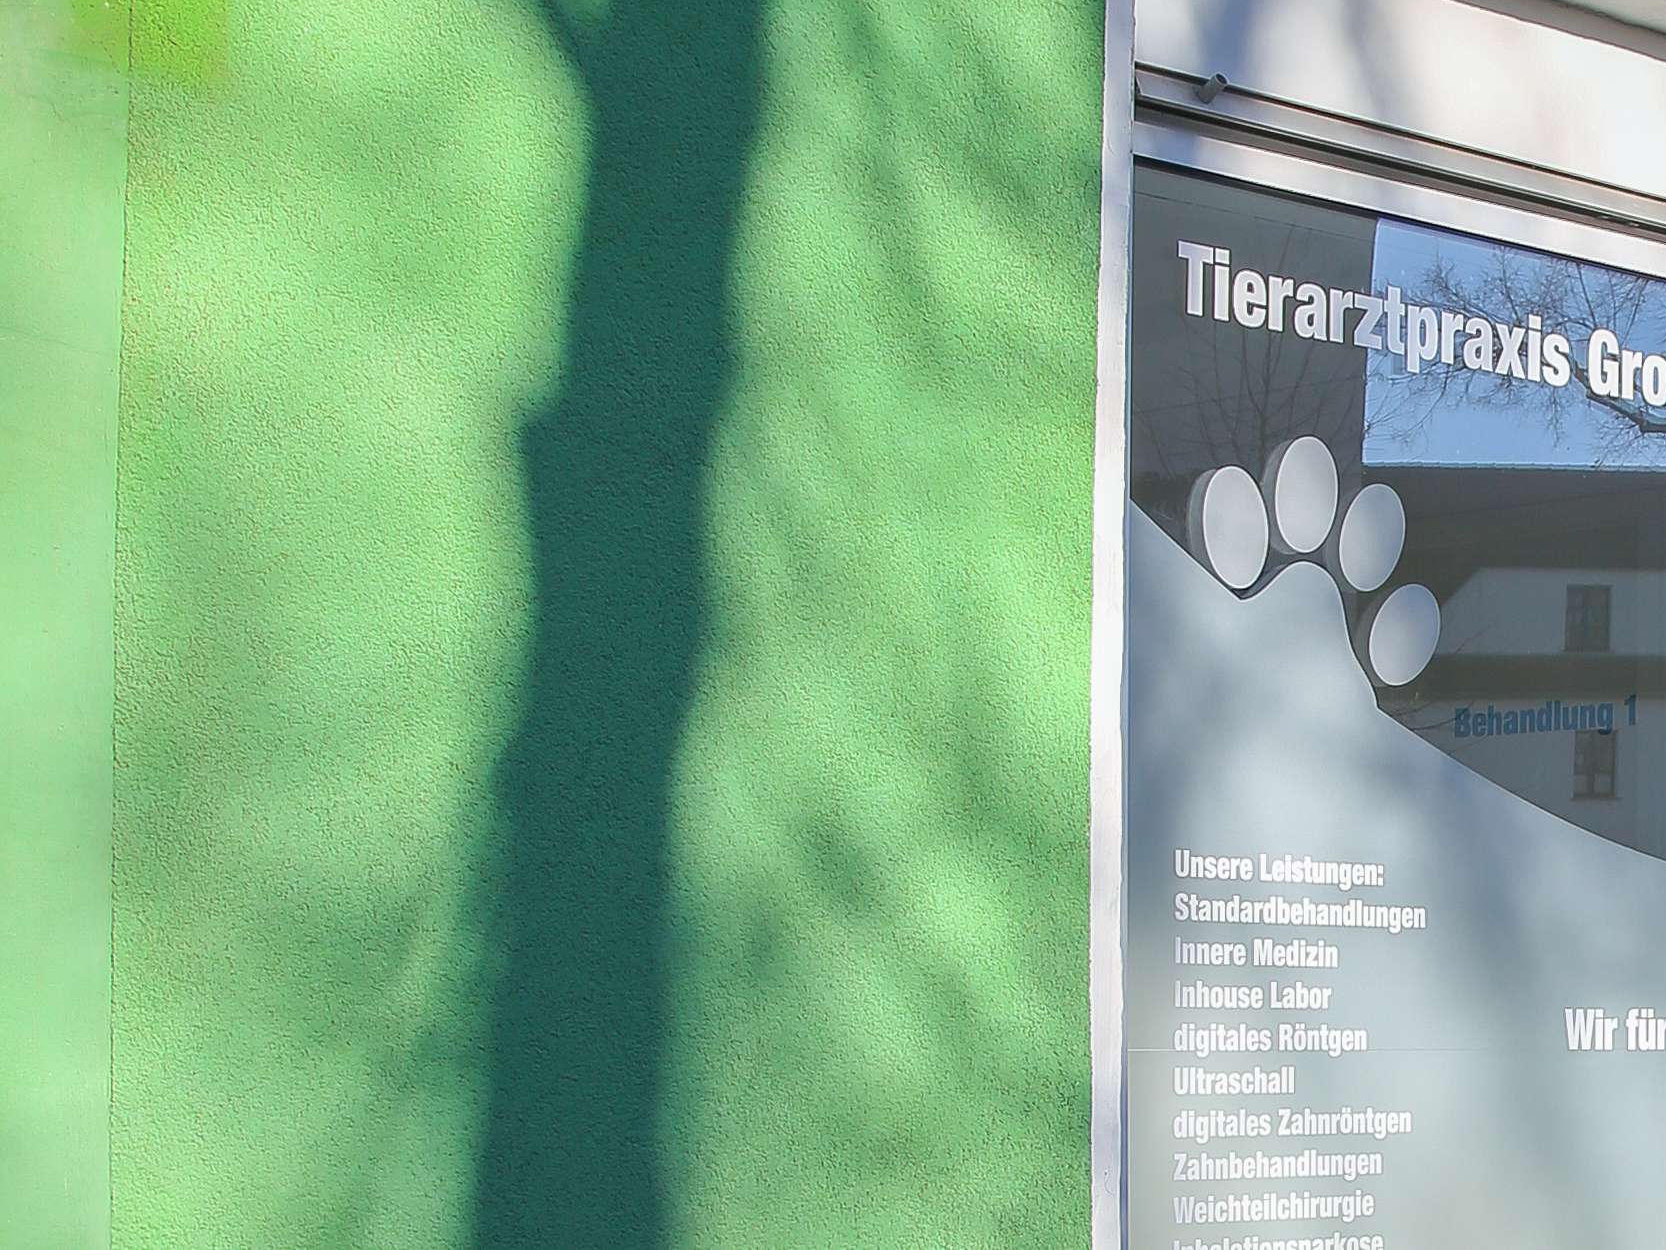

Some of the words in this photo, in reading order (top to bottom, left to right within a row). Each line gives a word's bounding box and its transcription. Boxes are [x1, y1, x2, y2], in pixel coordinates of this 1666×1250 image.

[1176, 240, 1571, 388] Tierarztpraxis
[1454, 701, 1614, 739] Behandlung
[1624, 694, 1637, 726] 1
[1174, 849, 1253, 881] Unsere
[1259, 853, 1385, 890] Leistungen:
[1174, 893, 1427, 934] Standardbehandlungen
[1174, 936, 1247, 966] Innere
[1253, 938, 1339, 968] Medizin
[1174, 980, 1263, 1009] Inhouse
[1270, 981, 1332, 1009] Labor
[1174, 1023, 1272, 1058] digitales
[1278, 1023, 1368, 1057] Röntgen
[1564, 1007, 1618, 1051] Wir
[1173, 1066, 1296, 1095] Ultraschall
[1173, 1108, 1271, 1144] digitales
[1277, 1106, 1413, 1139] Zahnröntgen
[1173, 1149, 1384, 1182] Zahnbehandlungen
[1173, 1189, 1375, 1224] Weichteilchirurgie
